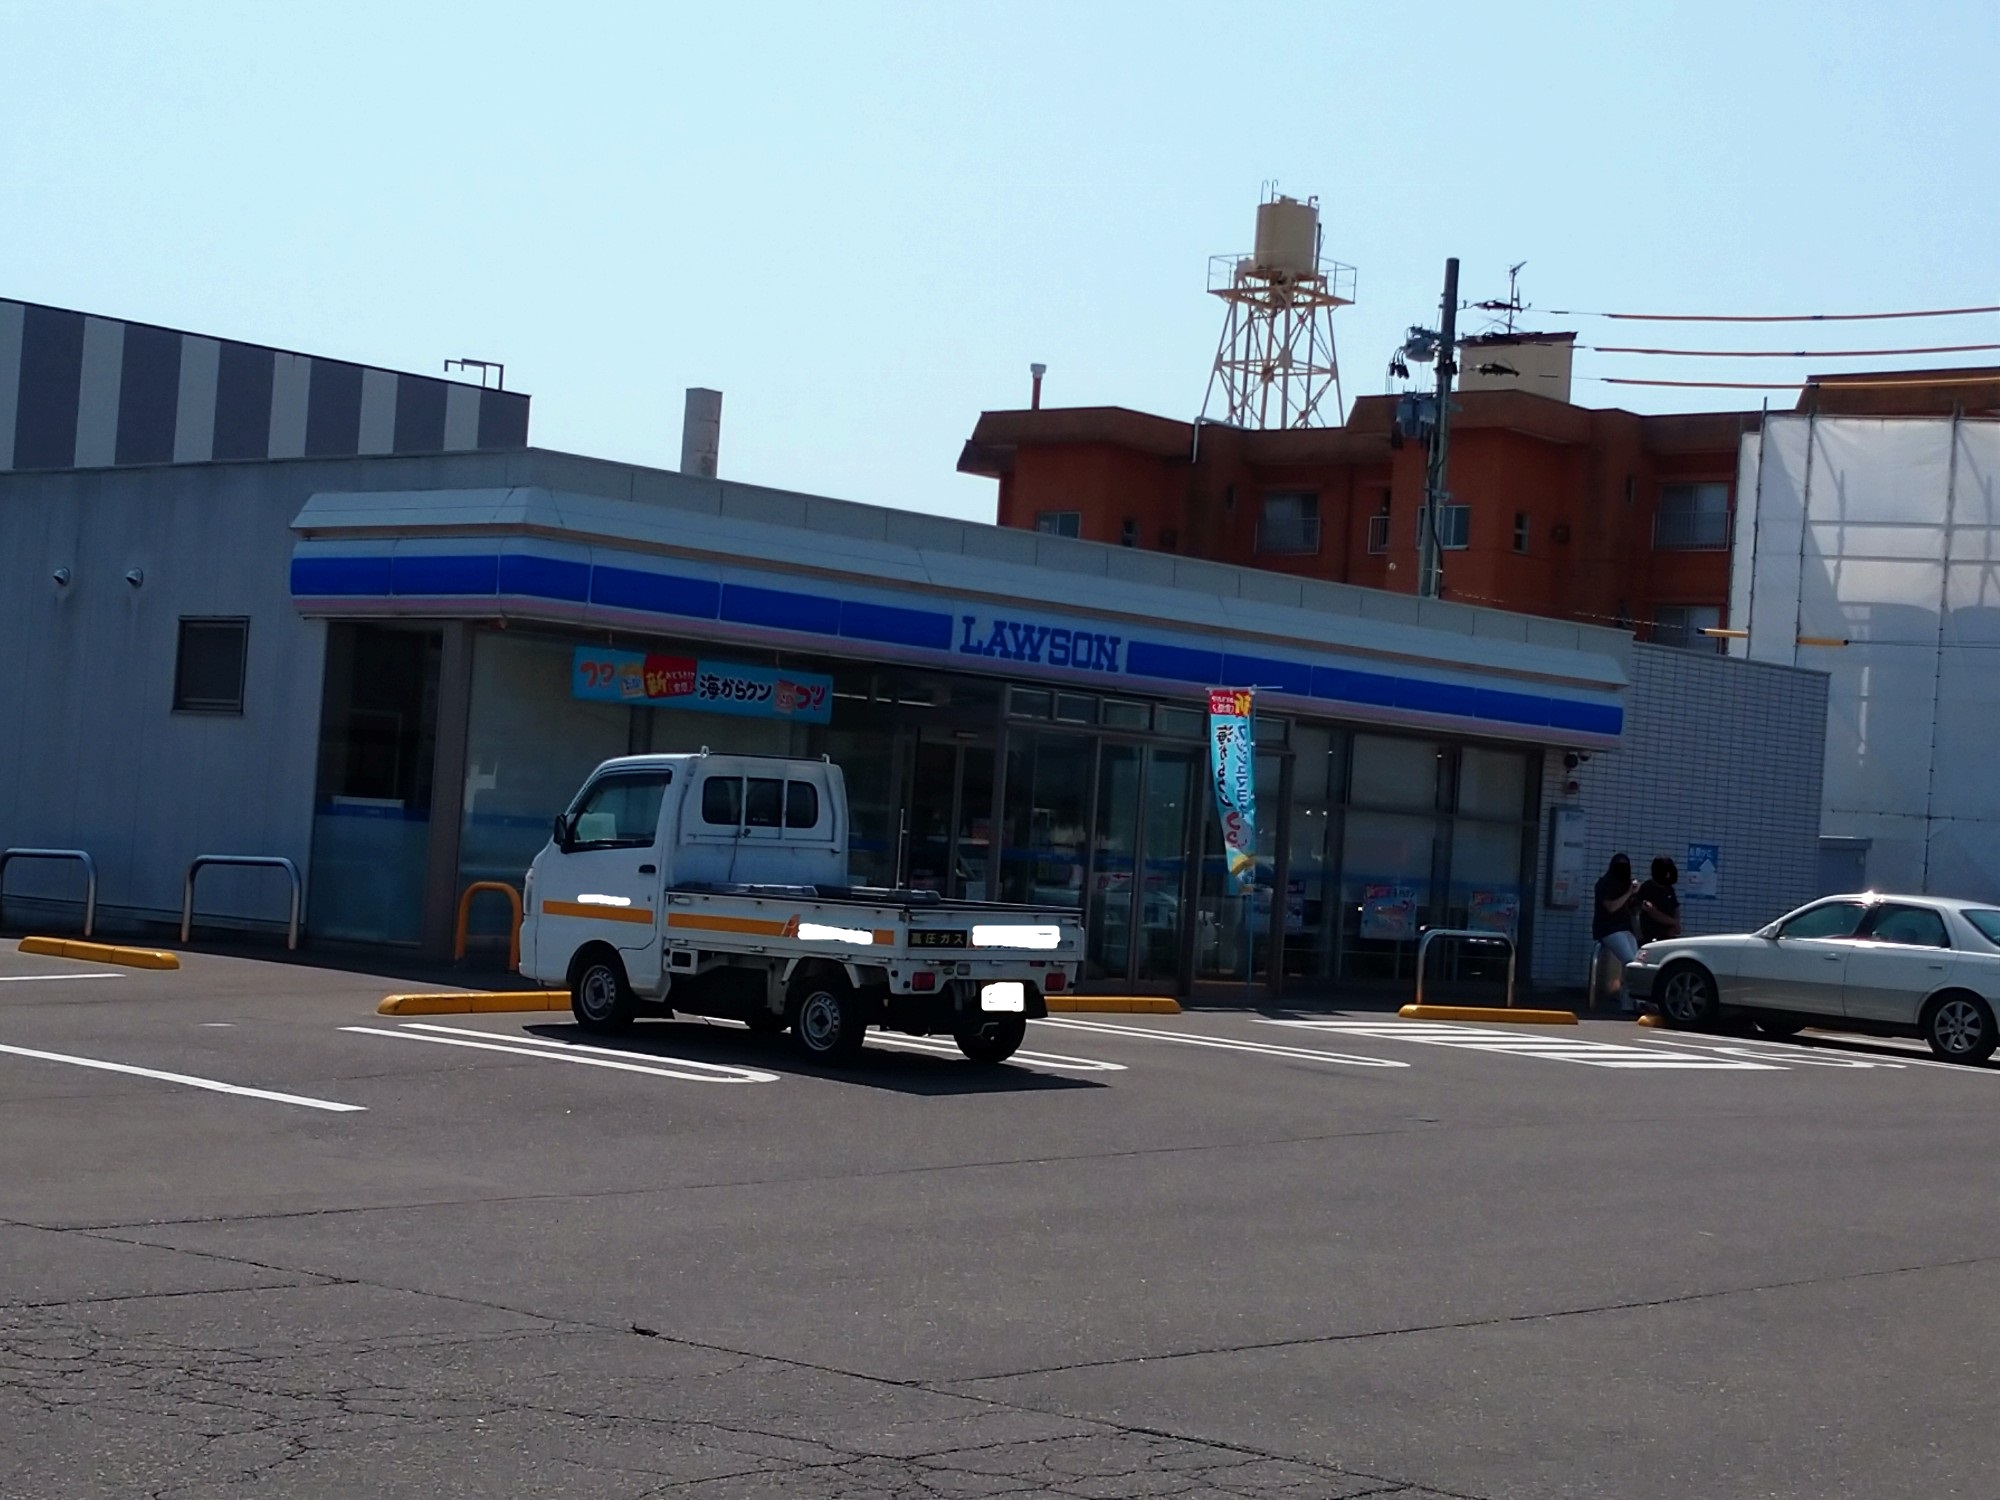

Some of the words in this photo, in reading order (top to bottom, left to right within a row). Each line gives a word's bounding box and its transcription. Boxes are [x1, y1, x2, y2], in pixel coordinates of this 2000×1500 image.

[960, 615, 1121, 673] LAWSON
[699, 673, 772, 702] 海からクン
[910, 932, 964, 945] 高圧ガス
